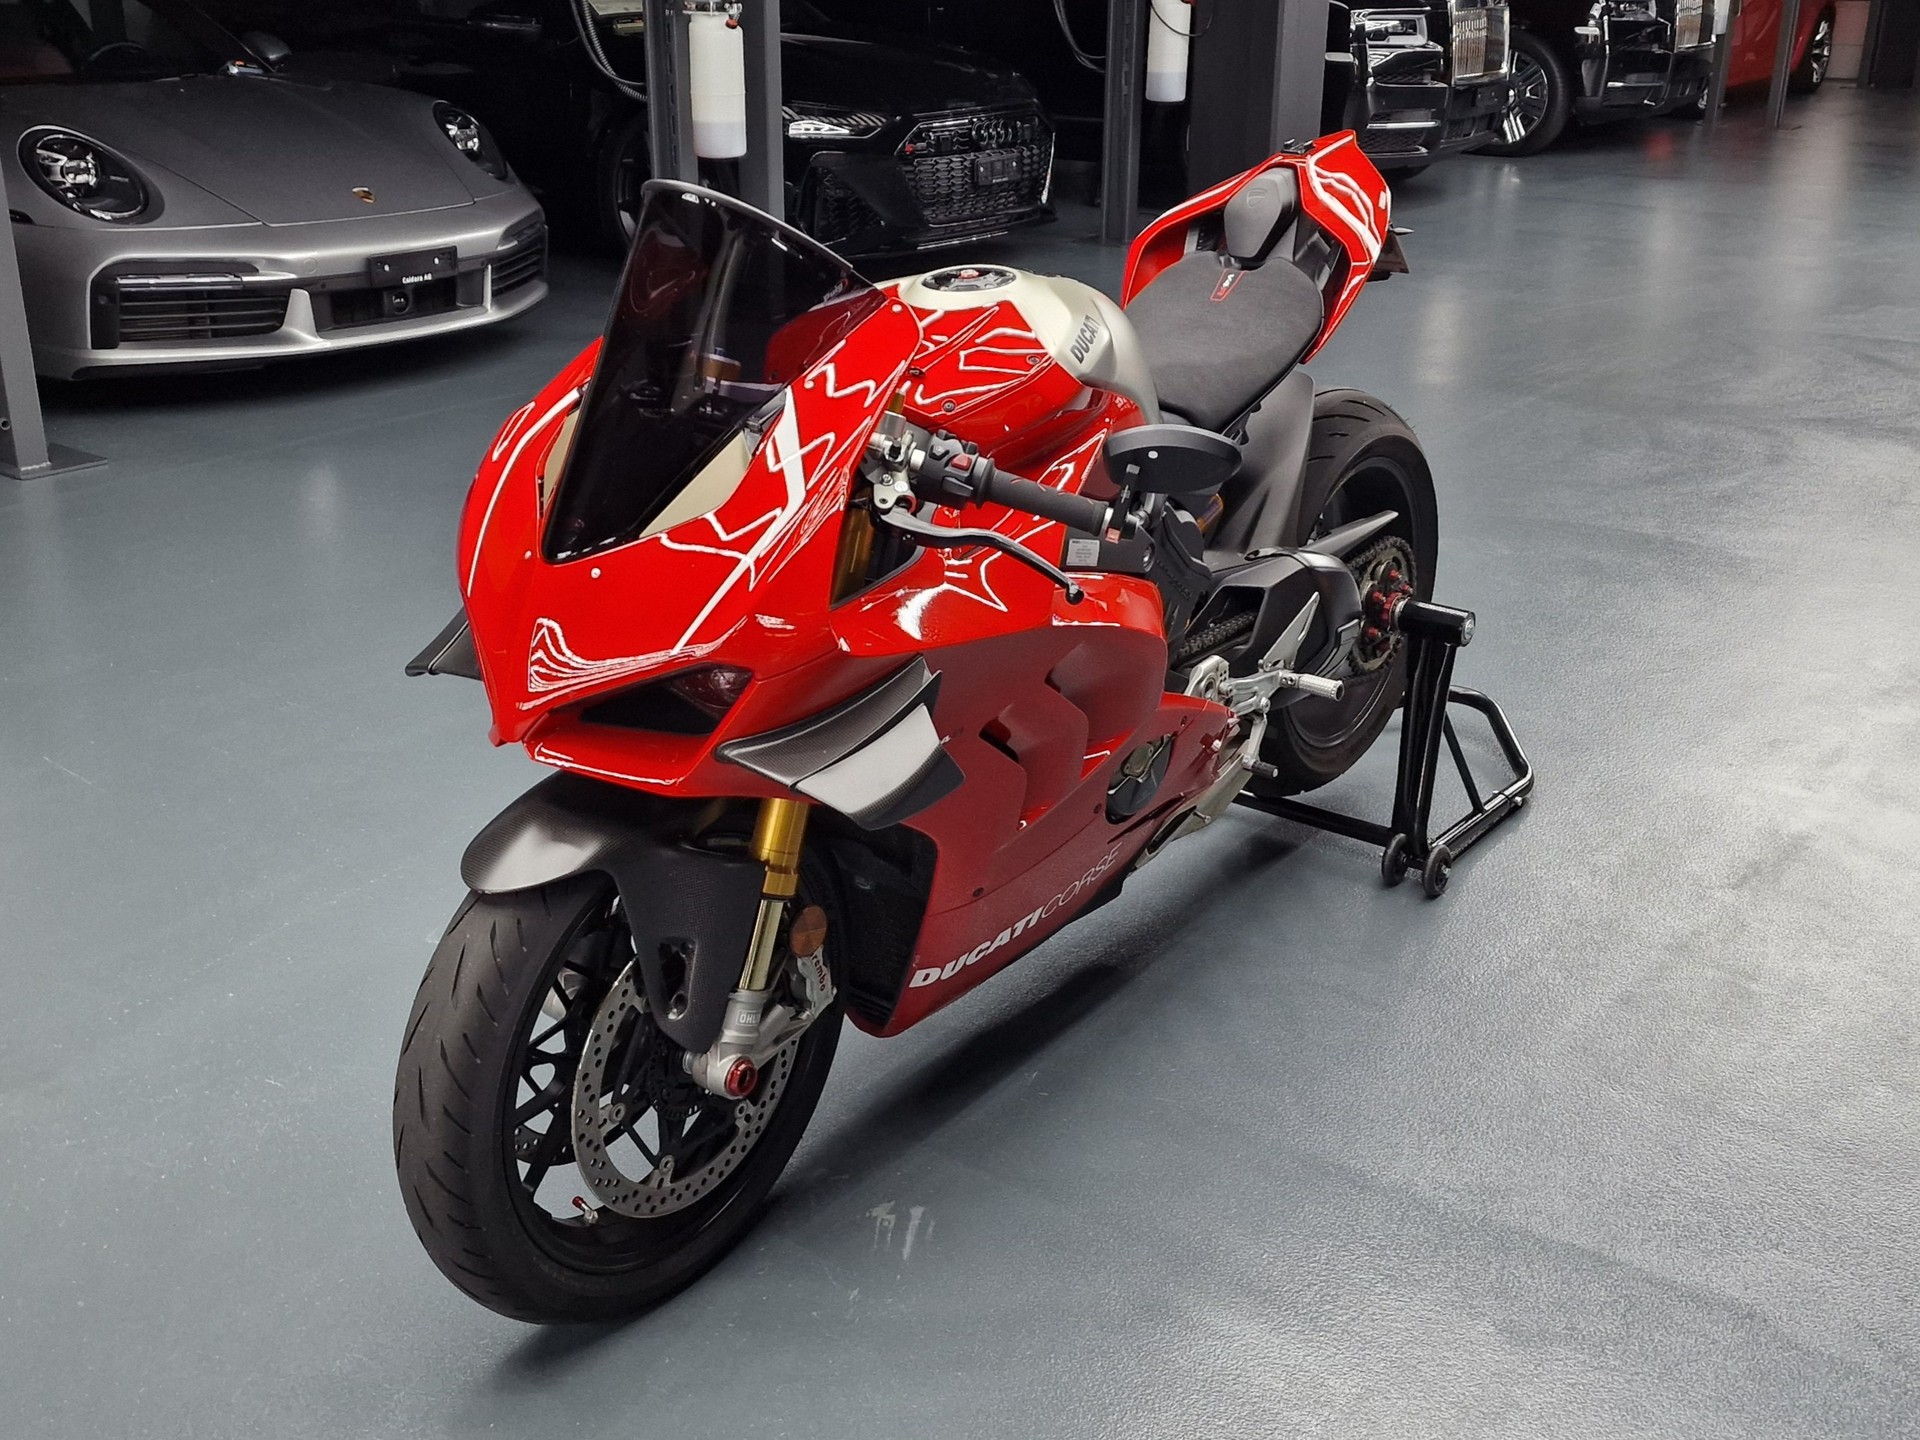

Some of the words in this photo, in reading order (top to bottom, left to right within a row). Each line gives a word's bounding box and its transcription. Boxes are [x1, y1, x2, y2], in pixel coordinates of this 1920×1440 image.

[1070, 314, 1101, 364] DUCATI
[812, 954, 827, 992] rembo
[739, 1010, 760, 1024] ÖHL
